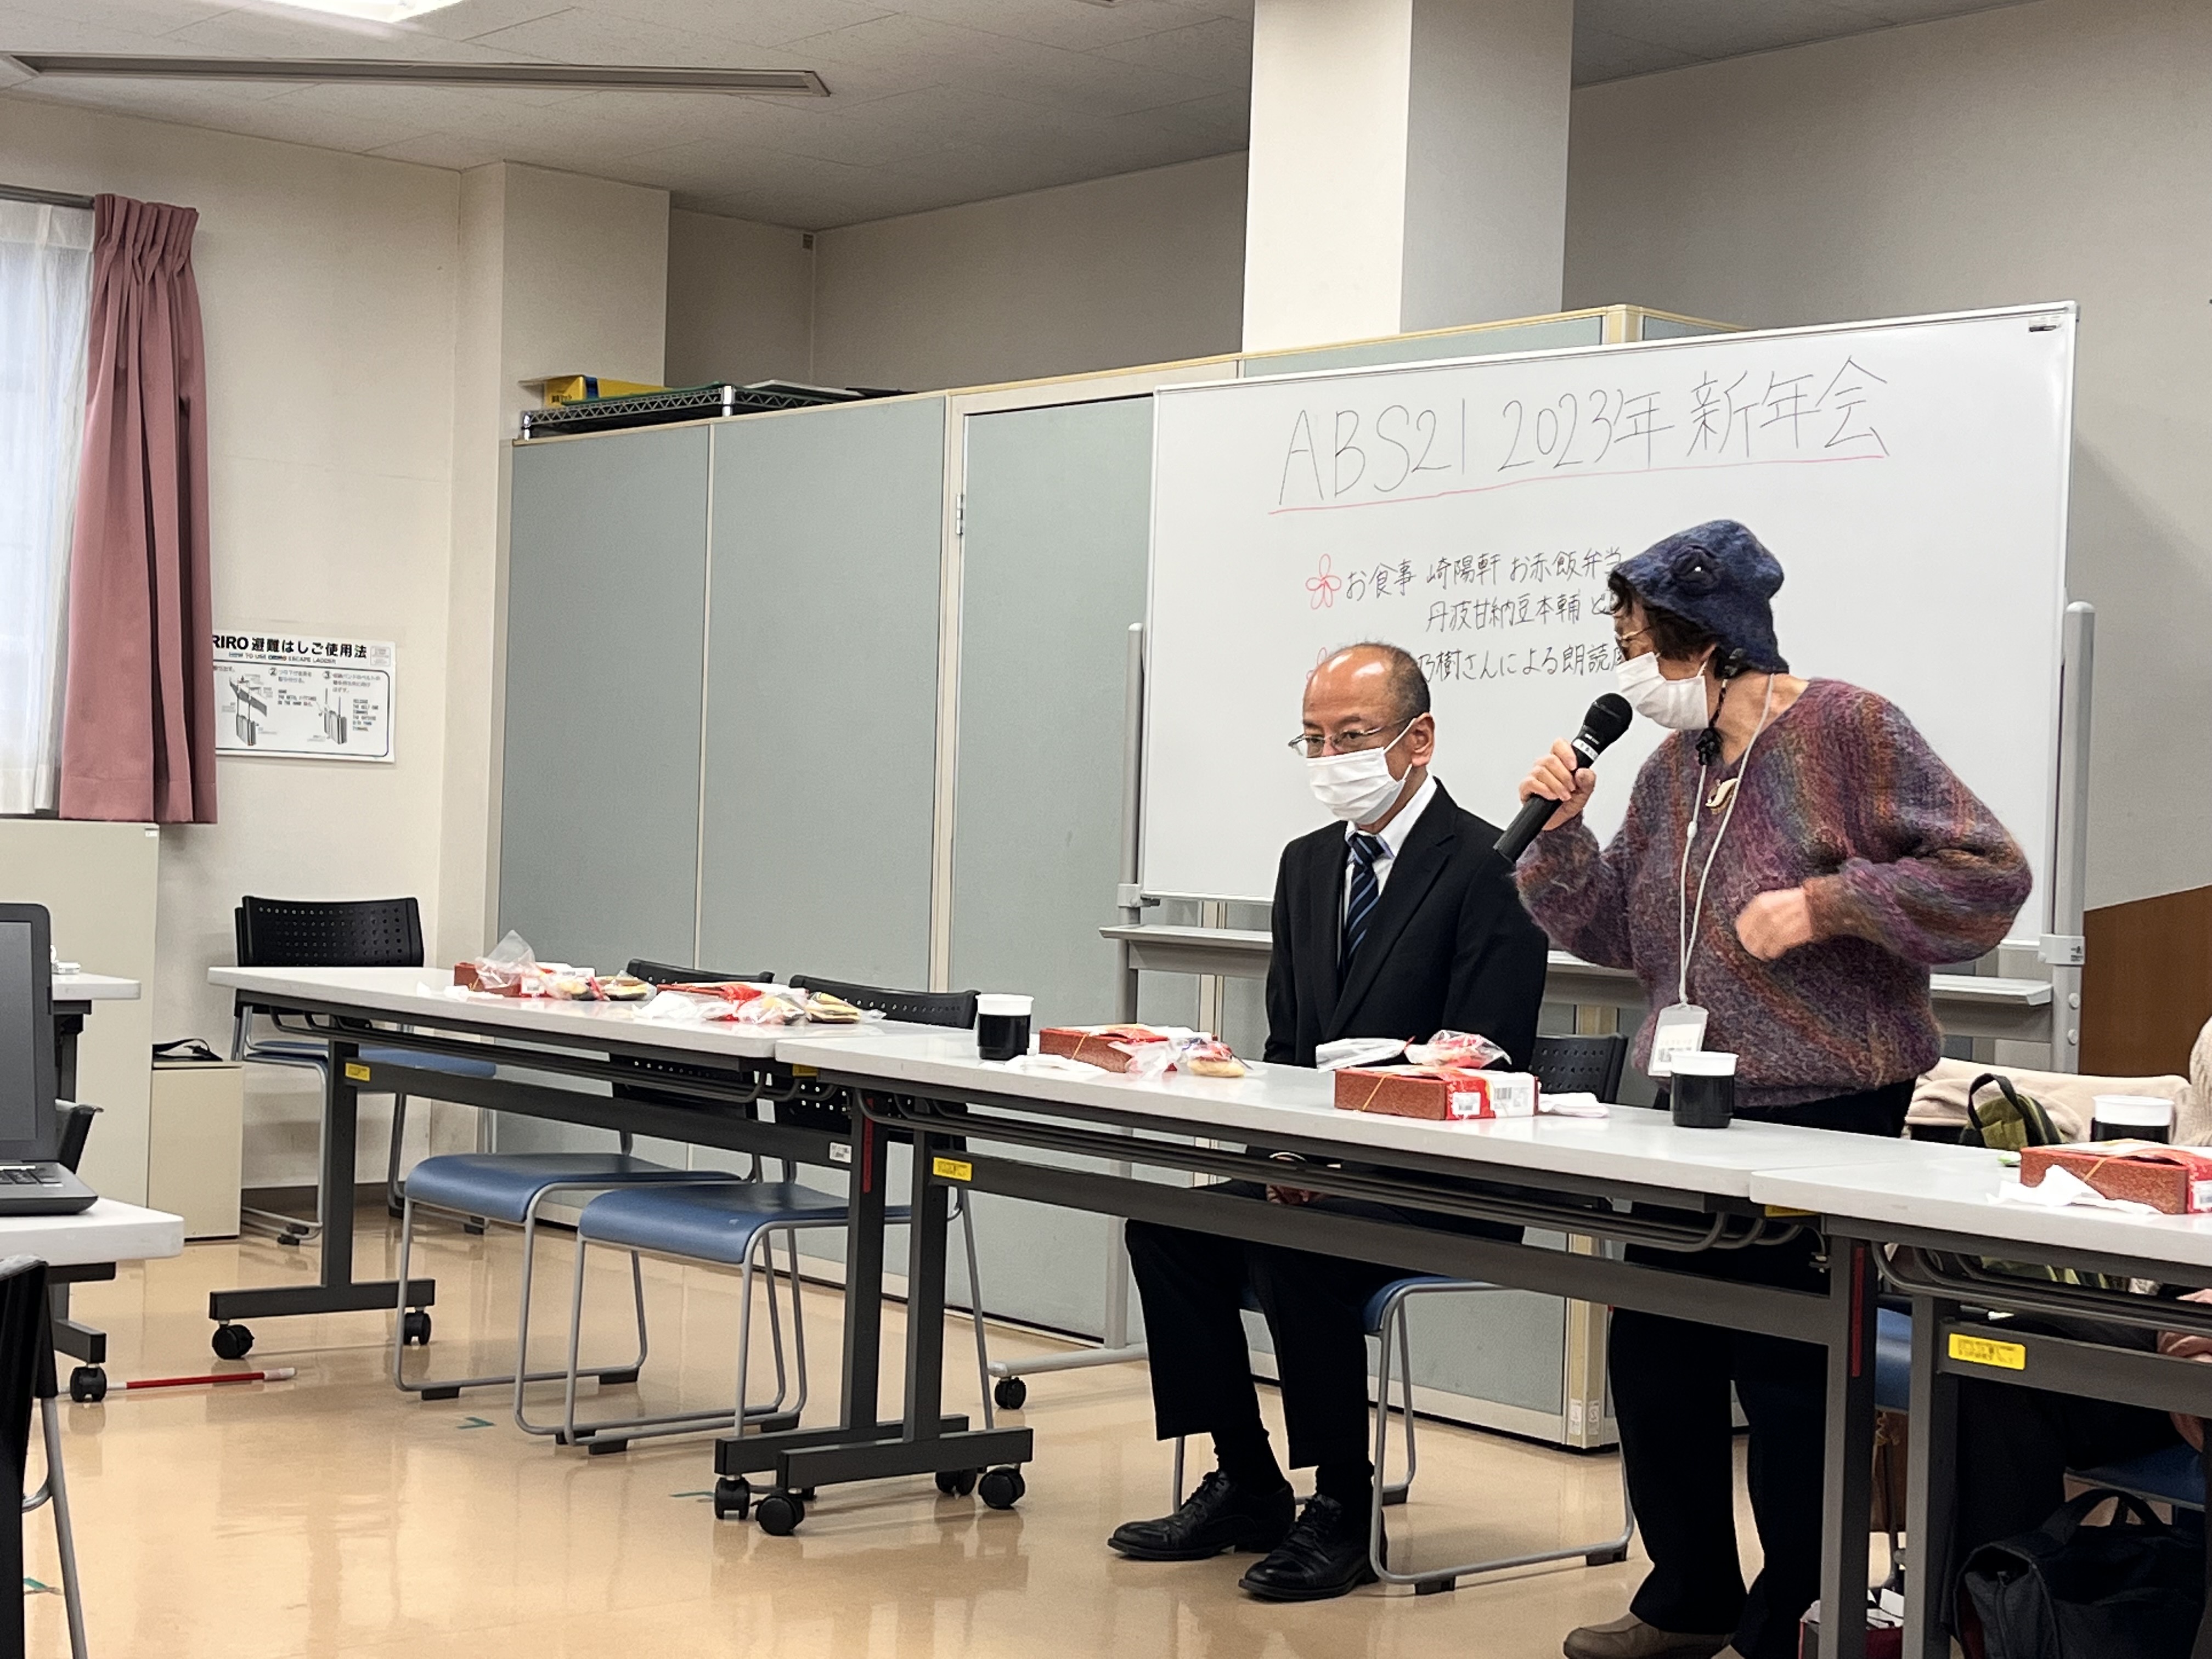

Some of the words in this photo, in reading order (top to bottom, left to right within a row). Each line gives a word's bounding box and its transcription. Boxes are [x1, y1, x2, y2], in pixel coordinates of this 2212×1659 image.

[1279, 398, 1465, 505] ABS21
[1497, 388, 1675, 472] 2023年
[1686, 355, 1890, 457] 新年会
[1346, 558, 1417, 602] お食事
[1426, 552, 1501, 590] 崎陽軒
[251, 637, 367, 659] 避難はしご使用法
[1417, 644, 1622, 682] 乃樹さんによる朗読
